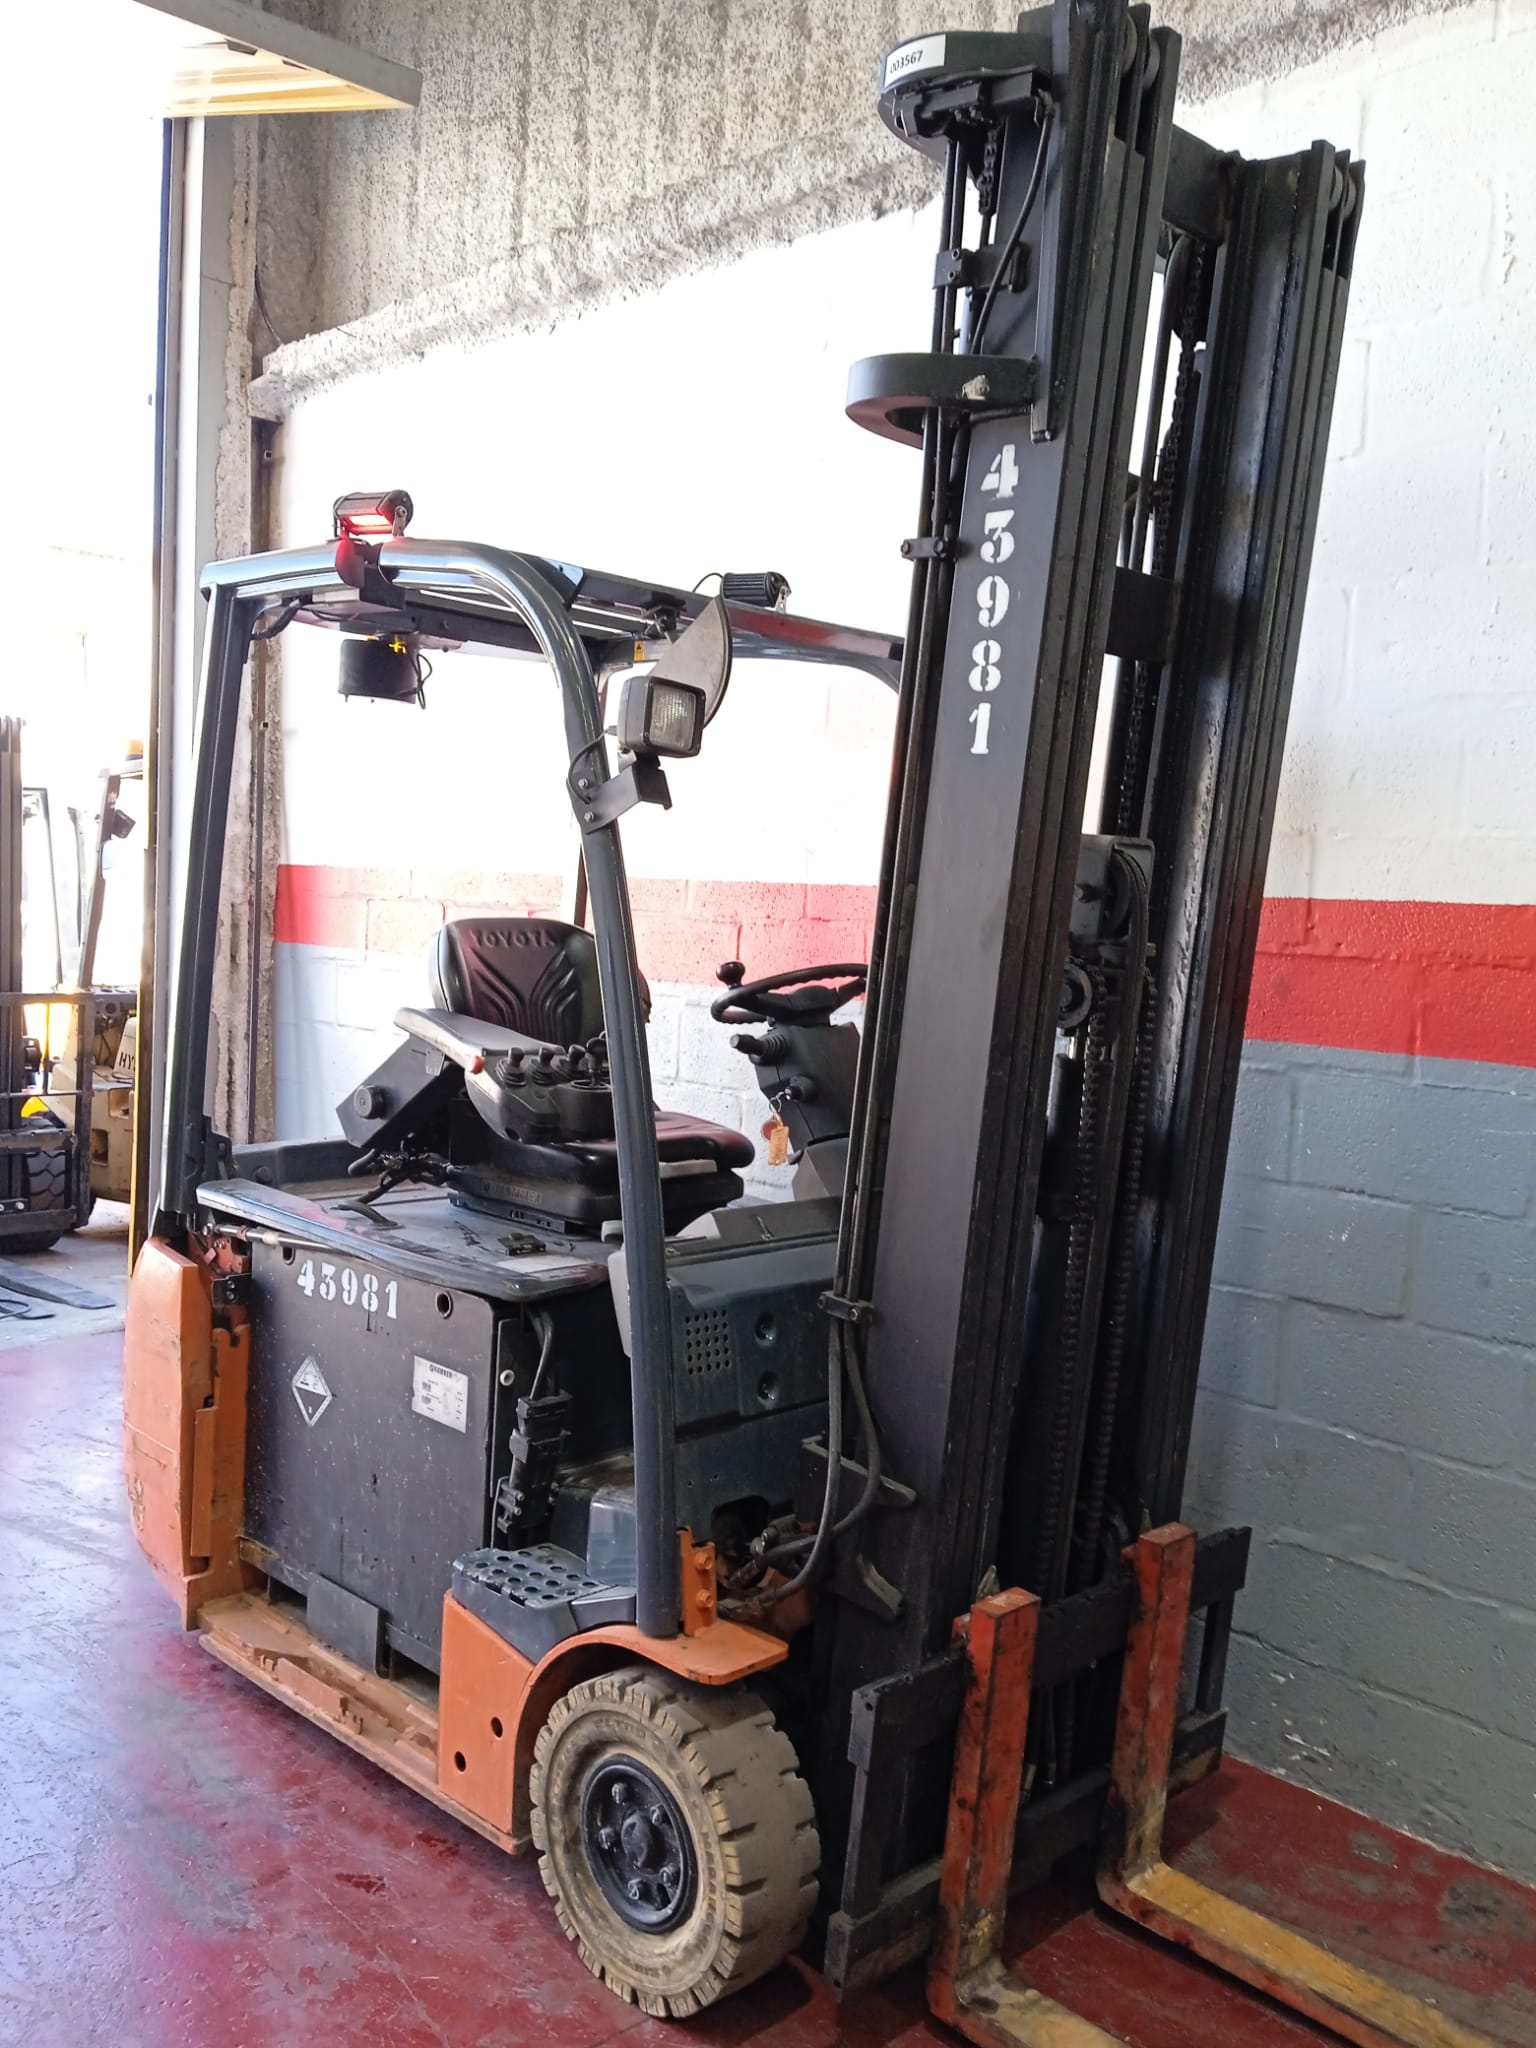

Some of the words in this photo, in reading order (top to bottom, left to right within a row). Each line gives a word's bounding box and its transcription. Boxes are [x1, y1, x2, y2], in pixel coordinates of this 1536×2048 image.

[889, 49, 924, 75] 003567
[968, 444, 1020, 755] 43981
[469, 927, 556, 949] TOYOTA
[297, 1259, 398, 1320] 43981
